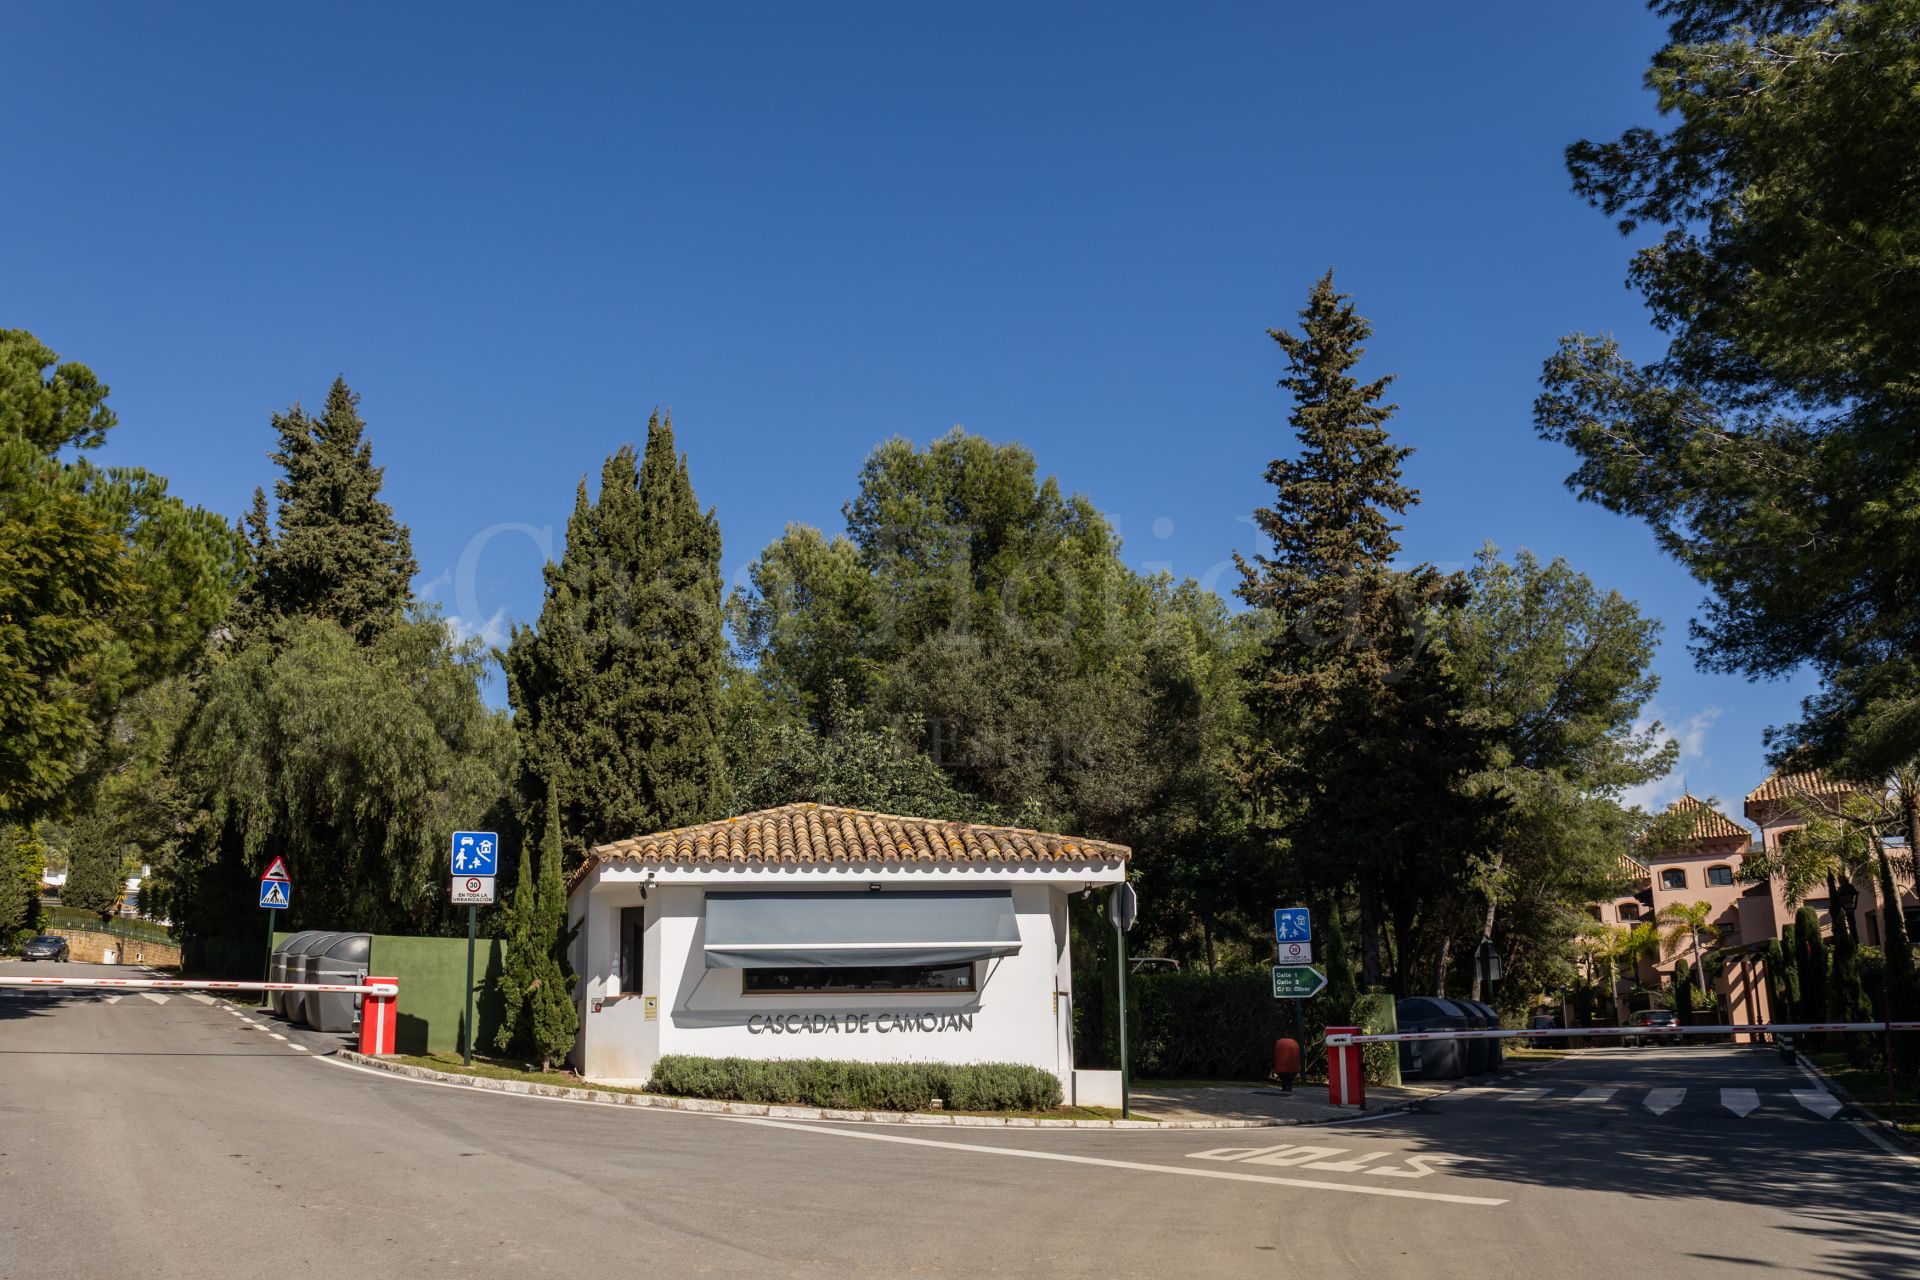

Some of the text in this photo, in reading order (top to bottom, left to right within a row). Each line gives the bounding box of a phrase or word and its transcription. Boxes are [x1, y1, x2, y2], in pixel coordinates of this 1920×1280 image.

[747, 1012, 974, 1034] CASCADA DE CAMOJAN
[1185, 1144, 1468, 1178] STOP
